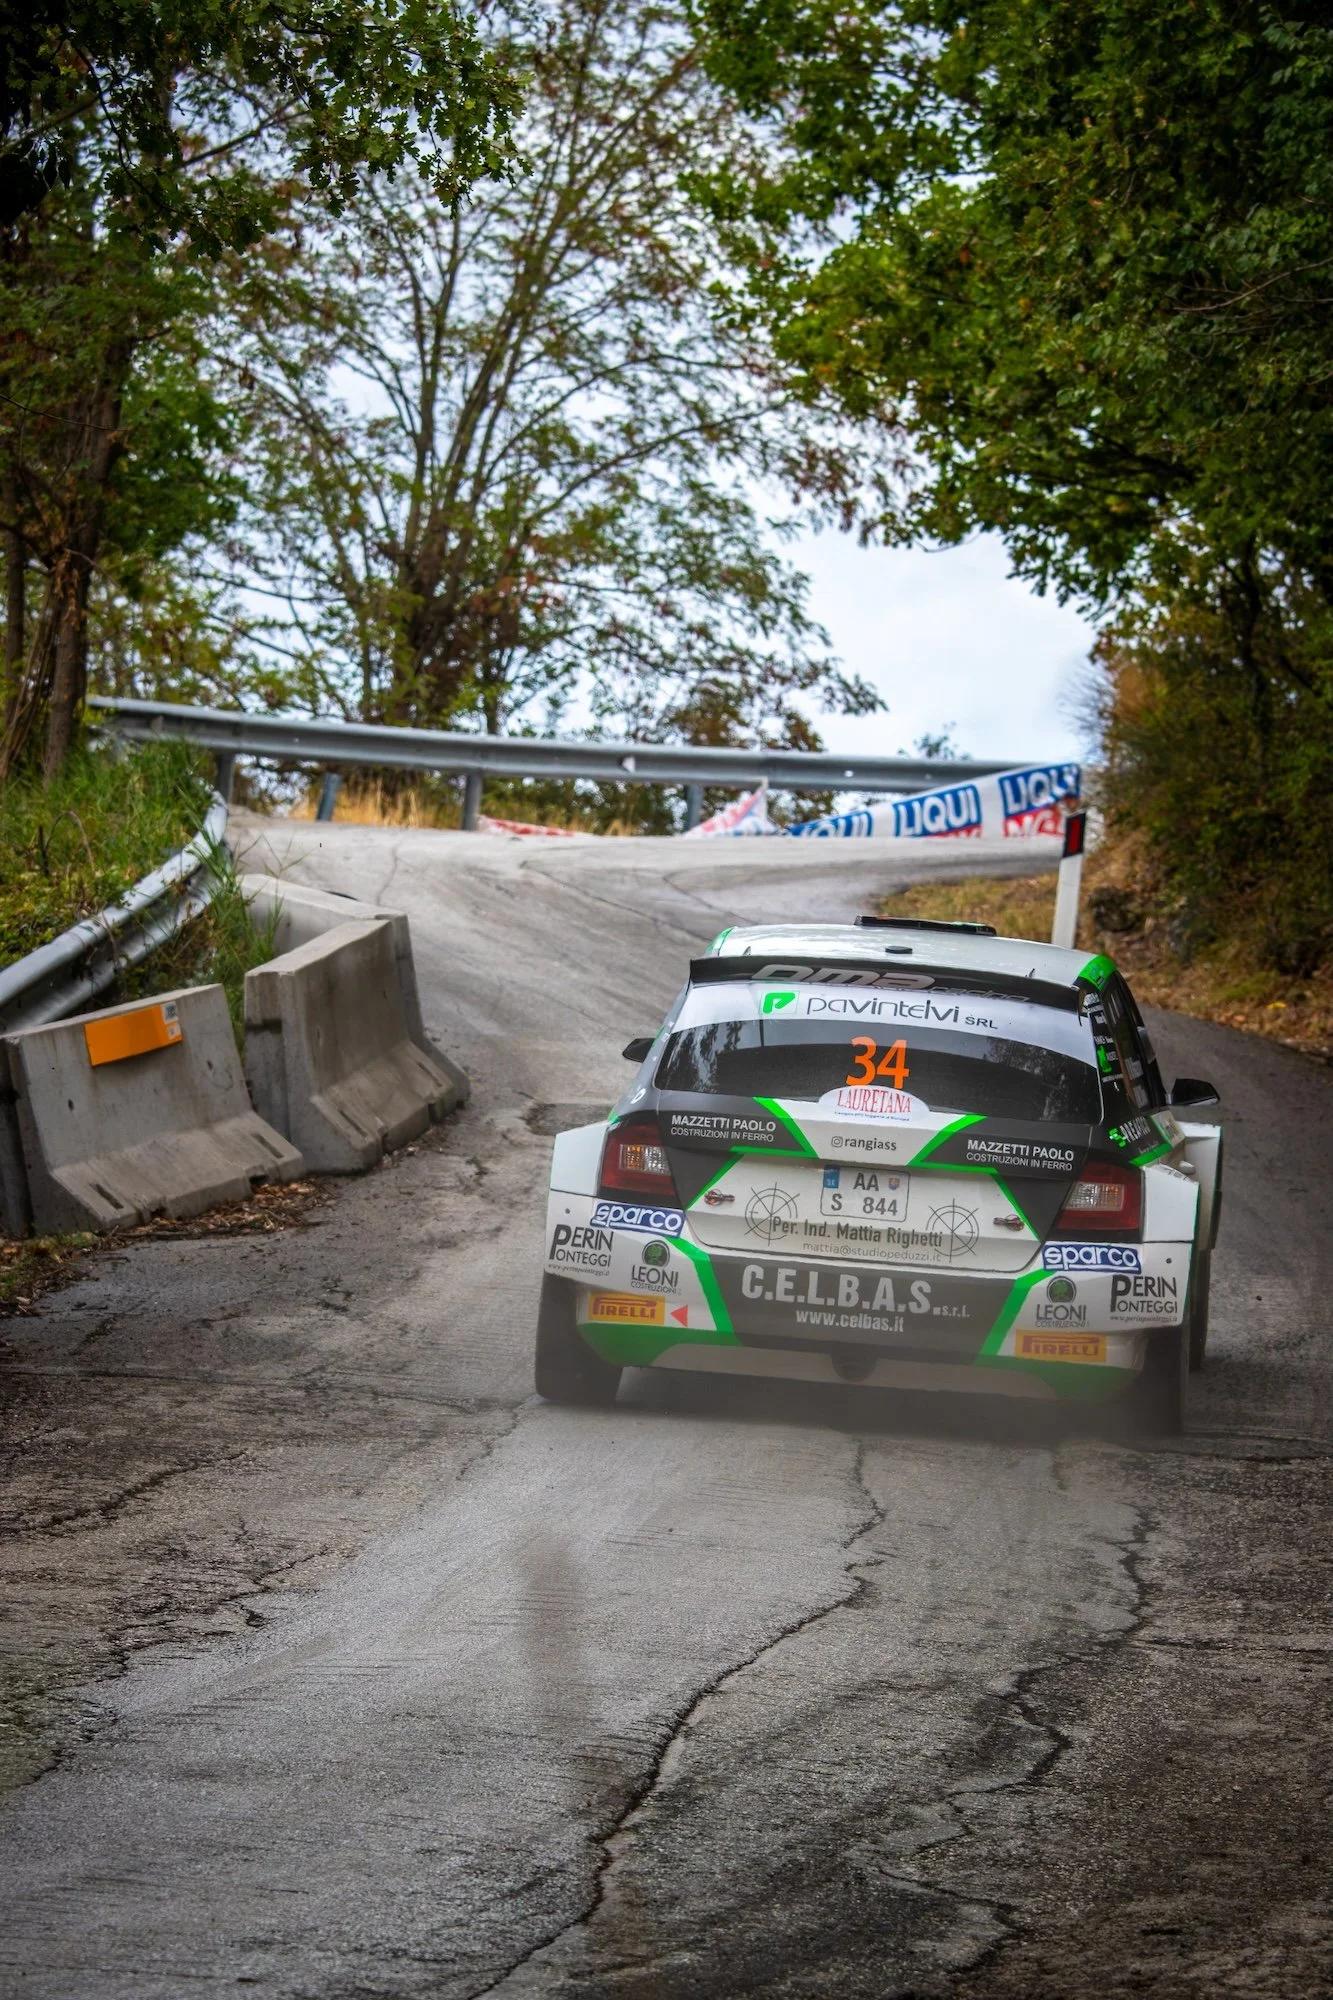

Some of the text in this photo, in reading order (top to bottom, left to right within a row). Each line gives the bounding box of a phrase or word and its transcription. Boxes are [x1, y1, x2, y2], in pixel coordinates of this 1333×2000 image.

[897, 787, 978, 836] LIQUI
[802, 811, 869, 837] QUI
[807, 997, 998, 1029] pavintelvi SRL
[846, 1036, 910, 1089] 34
[837, 1088, 911, 1114] LAURETANA
[670, 1127, 774, 1142] COSTRUZIONI IN FERRO
[671, 1115, 776, 1132] MAZZETTI PAOLO
[844, 1137, 897, 1151] rangiass
[967, 1139, 1074, 1161] MAZZETTI PAOLO
[966, 1152, 1073, 1171] COSTRUZIONI IN FERRO
[853, 1172, 879, 1191] AA
[831, 1193, 898, 1216] S 844
[596, 1205, 682, 1231] sparco
[549, 1224, 614, 1260] PERIN
[772, 1216, 943, 1249] Per. Ind. Mattia Righetti
[1044, 1246, 1137, 1270] sparco
[631, 1280, 677, 1294] COSTRUZIONI
[632, 1264, 679, 1287] LEONI
[1110, 1275, 1177, 1312] PERIN
[592, 1295, 657, 1319] PIRELLI
[1036, 1304, 1087, 1320] LEONI
[796, 1310, 904, 1332] www.celbas.it
[1022, 1334, 1099, 1356] PIRELLI
